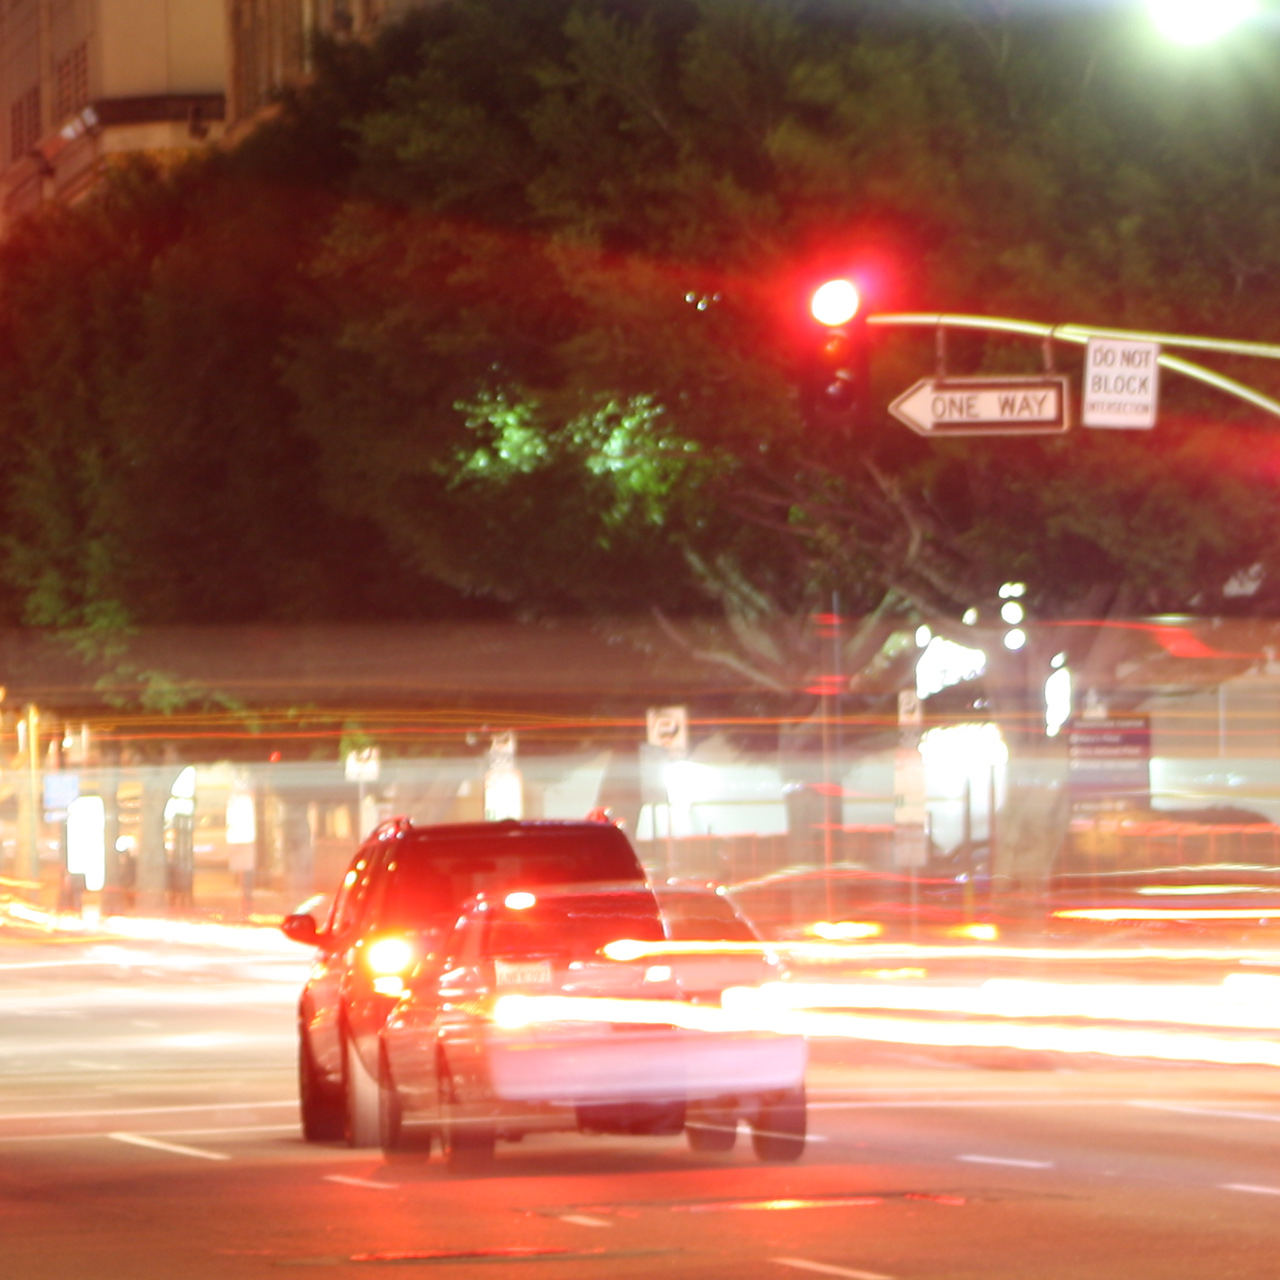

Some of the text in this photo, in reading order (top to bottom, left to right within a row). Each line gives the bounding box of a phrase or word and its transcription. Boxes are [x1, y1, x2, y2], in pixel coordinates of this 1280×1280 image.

[1092, 348, 1152, 368] DO NOT
[1090, 374, 1150, 395] BLOCK
[931, 394, 1048, 419] ONE WAY
